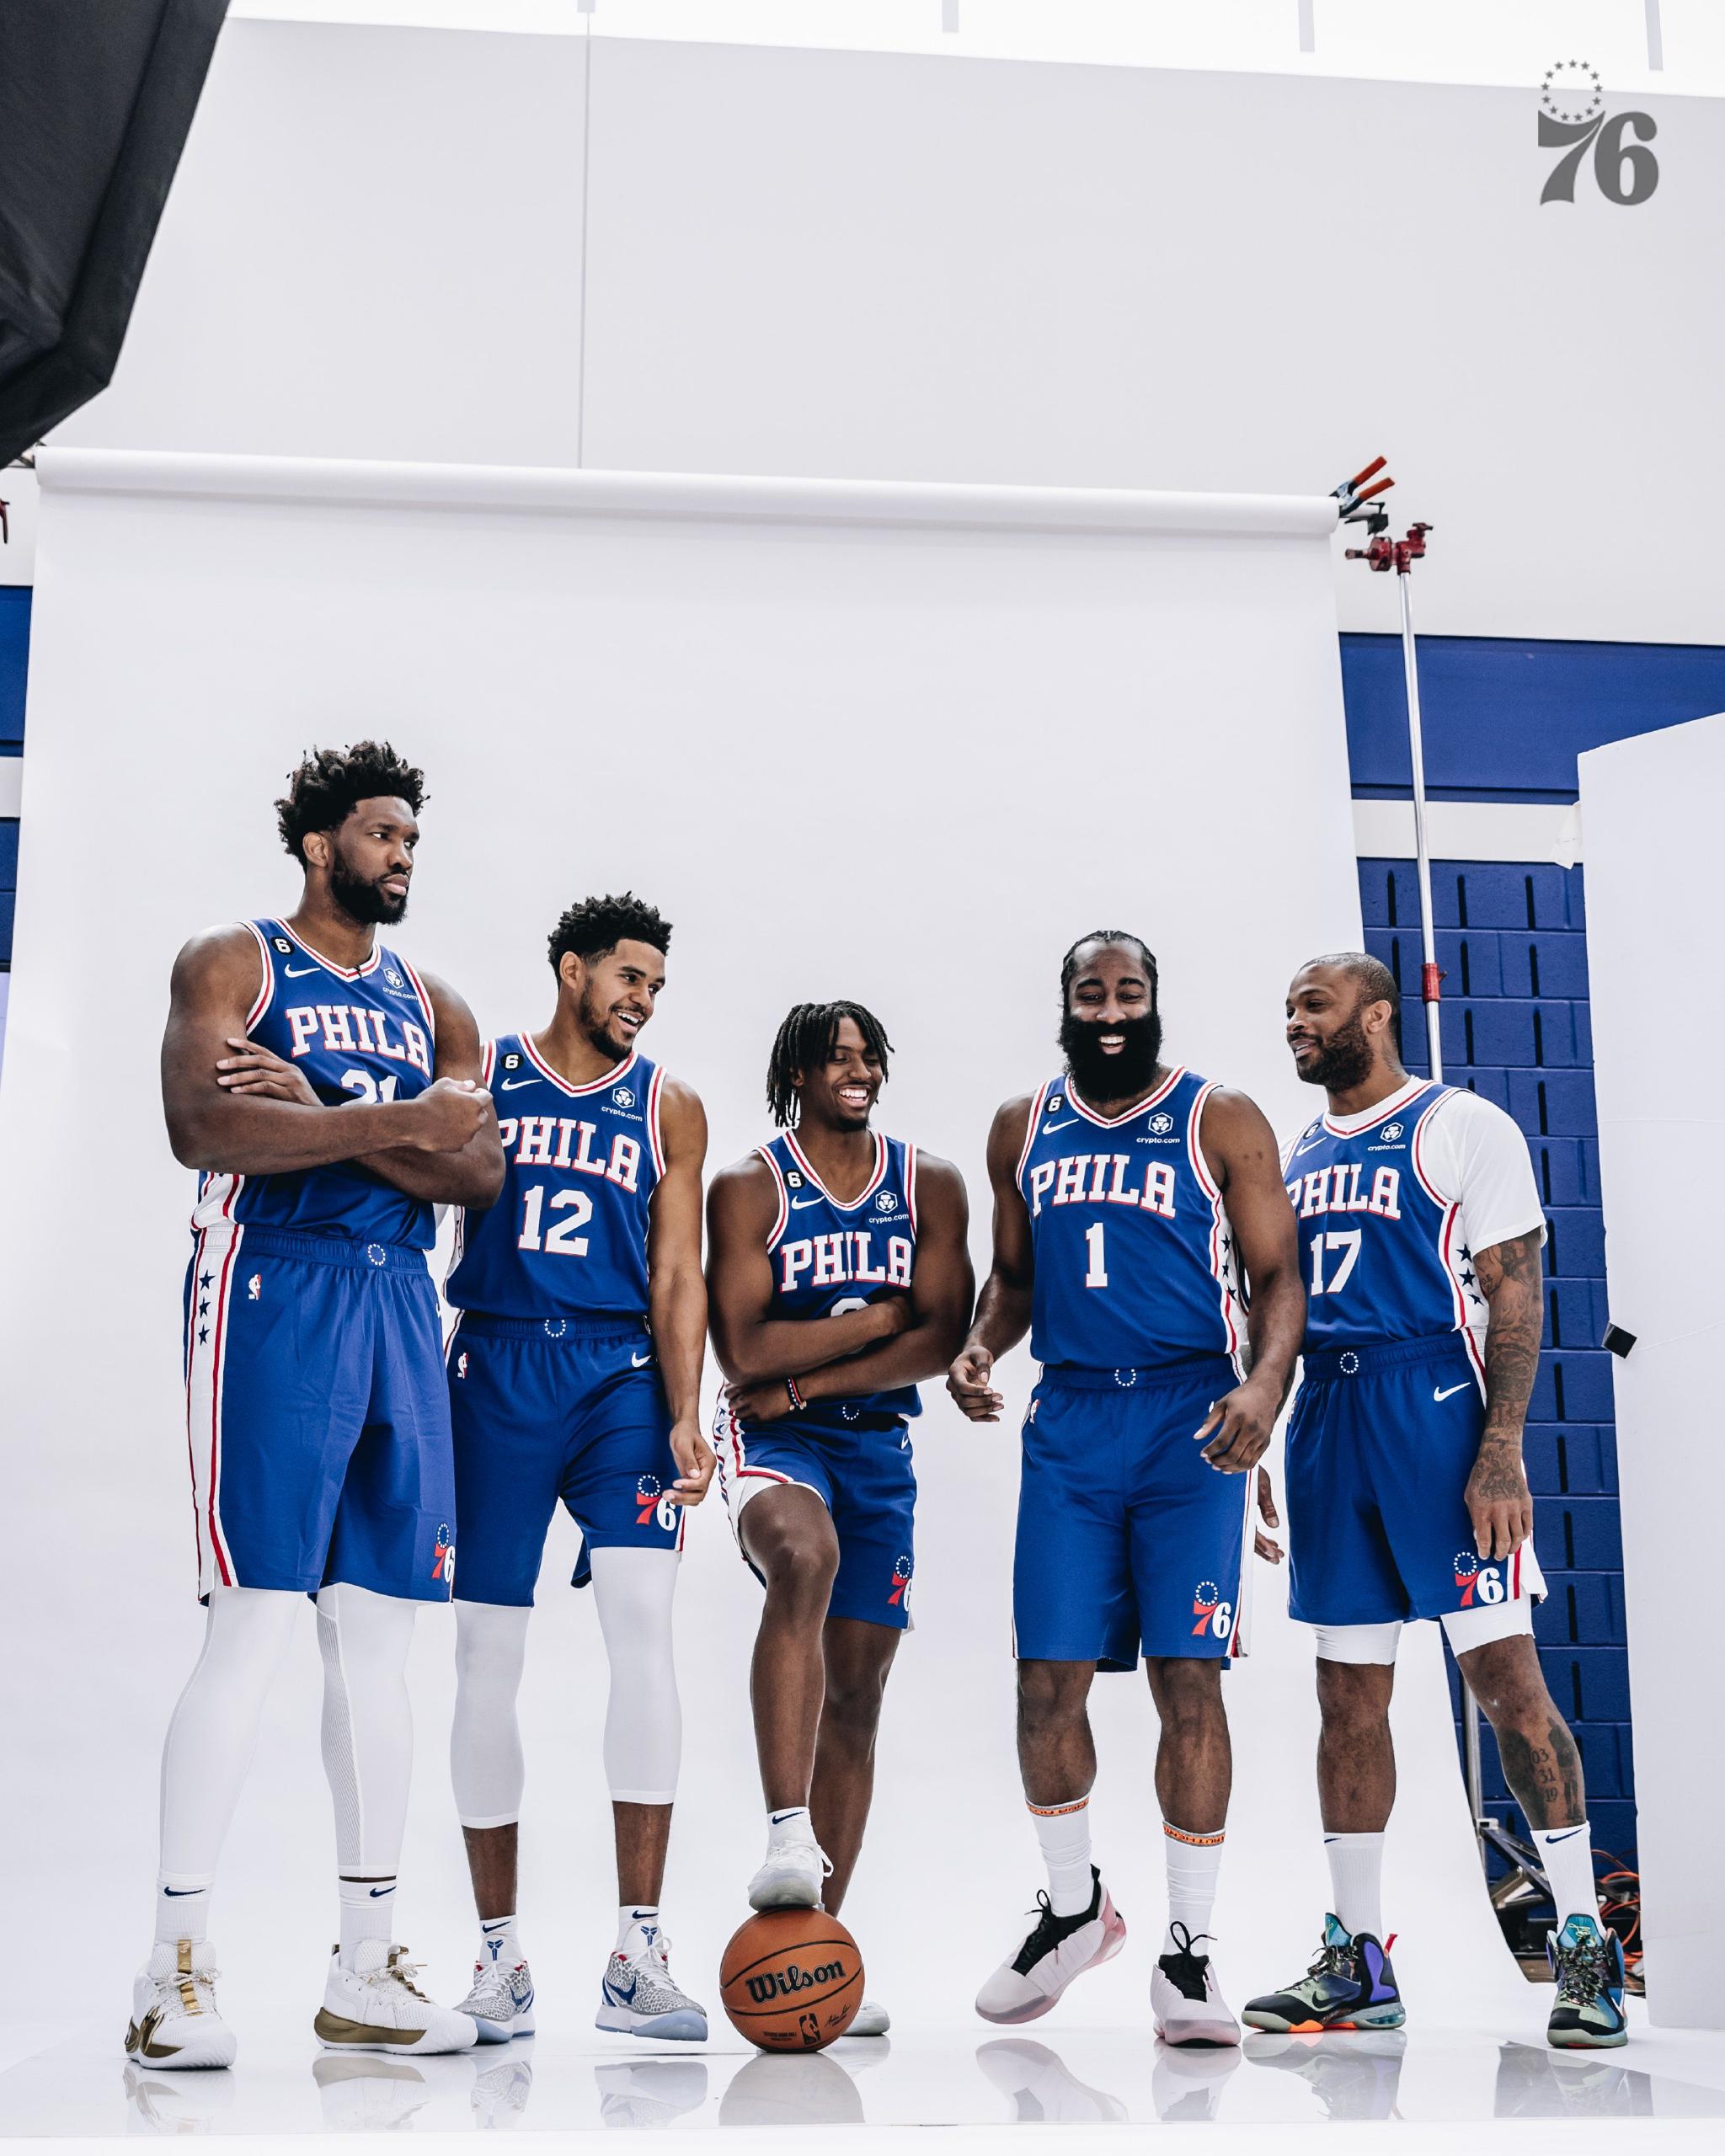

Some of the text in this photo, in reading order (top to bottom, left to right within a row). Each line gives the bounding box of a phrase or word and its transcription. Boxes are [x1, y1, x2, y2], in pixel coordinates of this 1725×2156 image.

[275, 939, 291, 953] 6
[382, 986, 418, 1001] crypto.com
[285, 1005, 431, 1079] PHILA
[505, 1054, 519, 1069] 6
[601, 1106, 643, 1122] crypto.com
[1047, 1097, 1061, 1112] 6
[787, 1171, 802, 1188] 6
[1030, 1153, 1176, 1220] PHILA
[517, 1185, 593, 1257] 12
[868, 1213, 910, 1225] crypto.com
[780, 1231, 912, 1294] PHILA
[1085, 1222, 1108, 1289] 1
[1310, 1228, 1361, 1296] 17
[635, 1492, 676, 1531] 76
[430, 1544, 456, 1583] 76
[1455, 1566, 1504, 1608] 76
[1192, 1600, 1231, 1639] 76
[745, 1961, 846, 2004] Wilson
